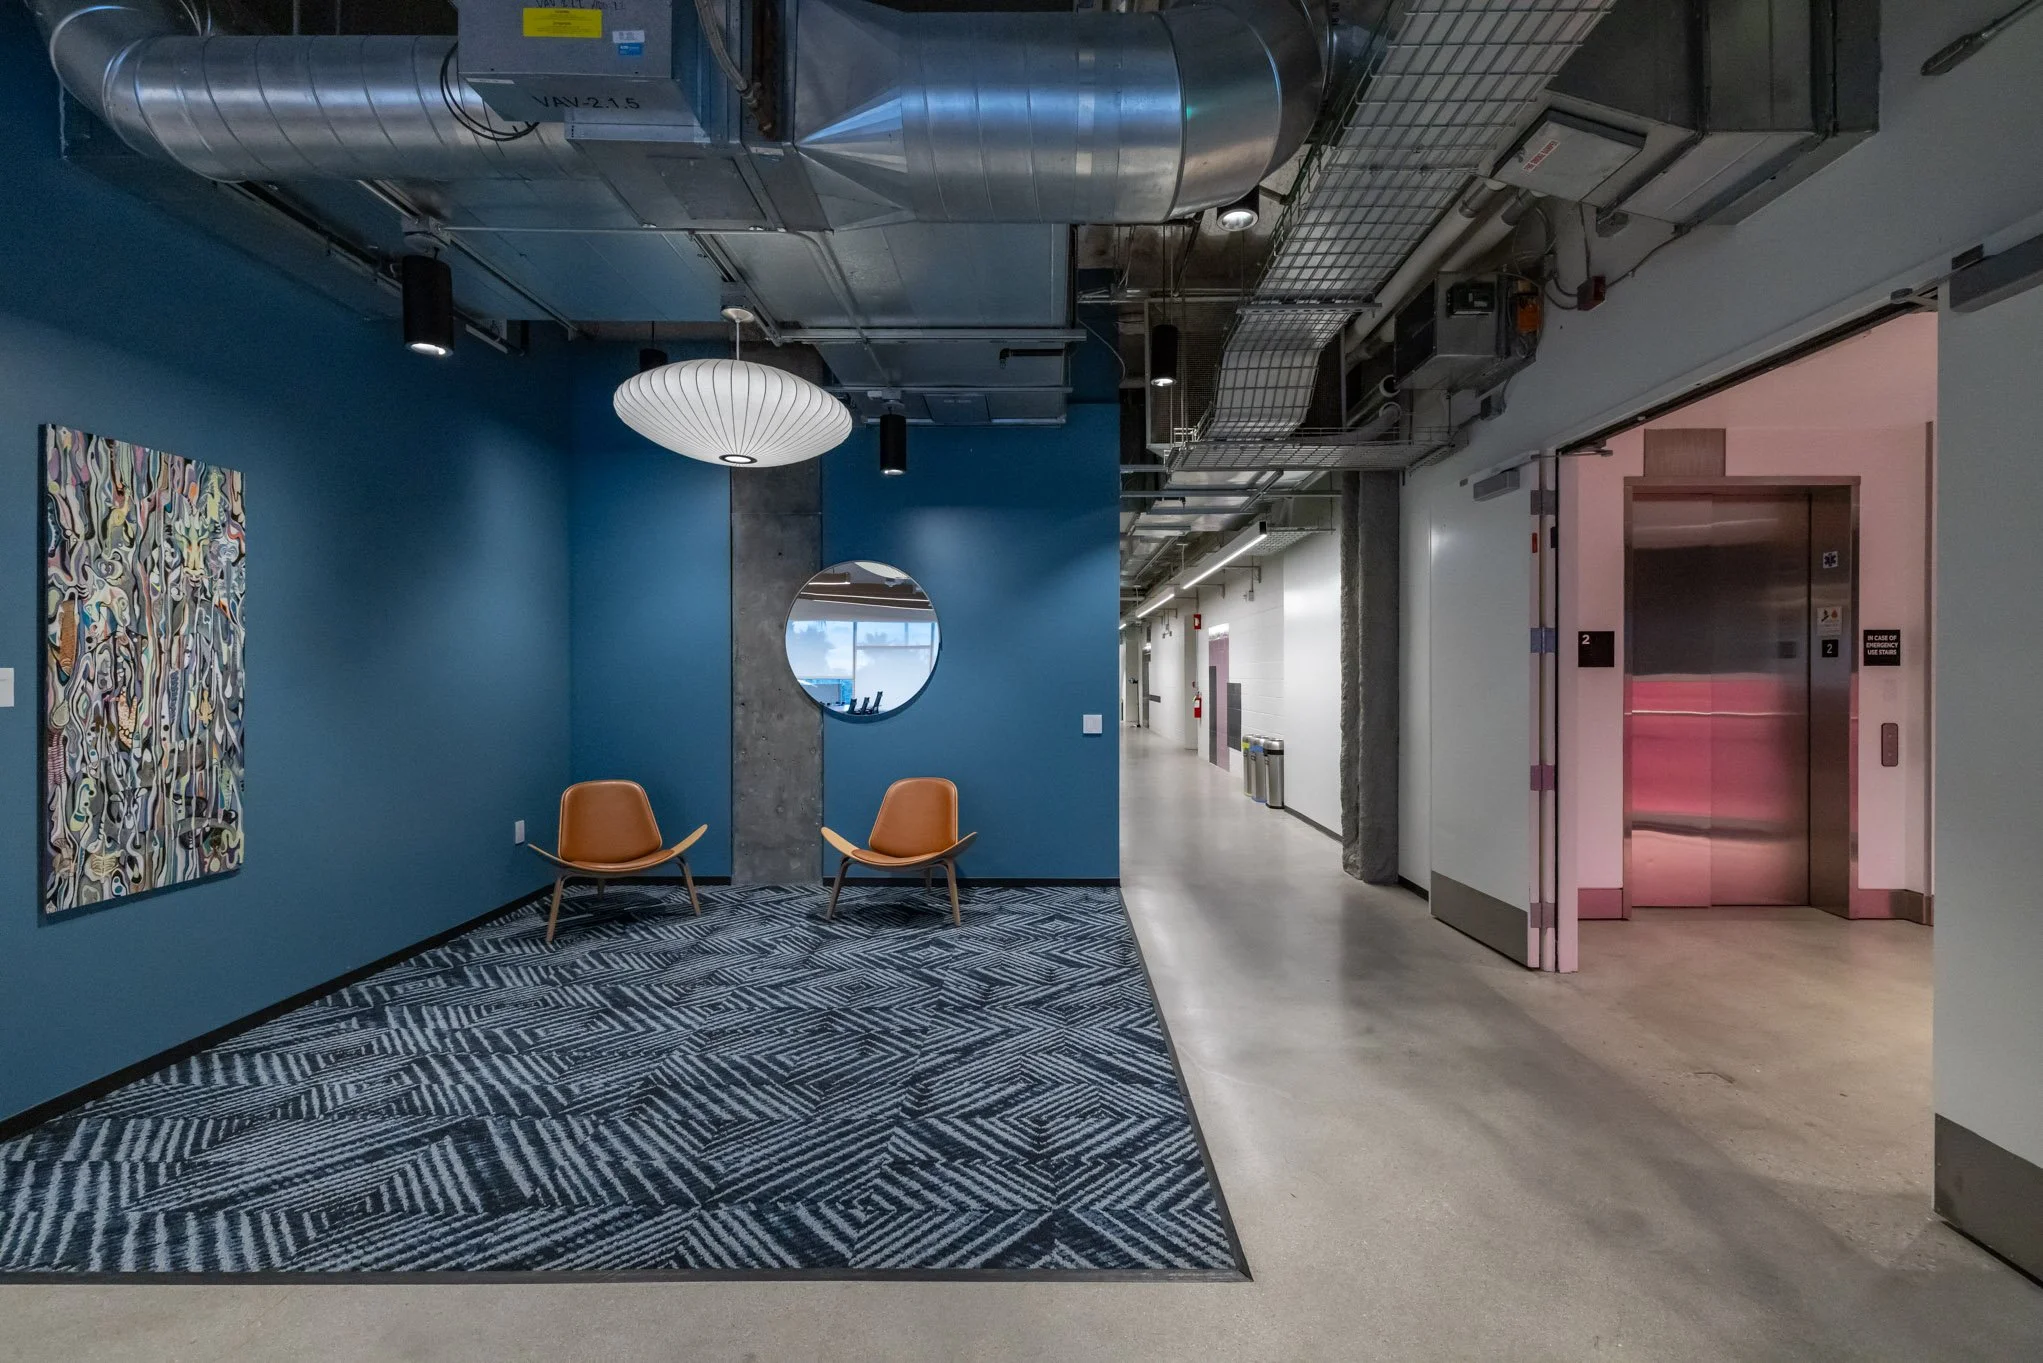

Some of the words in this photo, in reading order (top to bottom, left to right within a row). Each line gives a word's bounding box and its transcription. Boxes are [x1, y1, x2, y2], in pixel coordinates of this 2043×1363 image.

[532, 95, 640, 109] VAV-2.1.5
[1582, 634, 1590, 645] 2
[1826, 643, 1833, 654] 2
